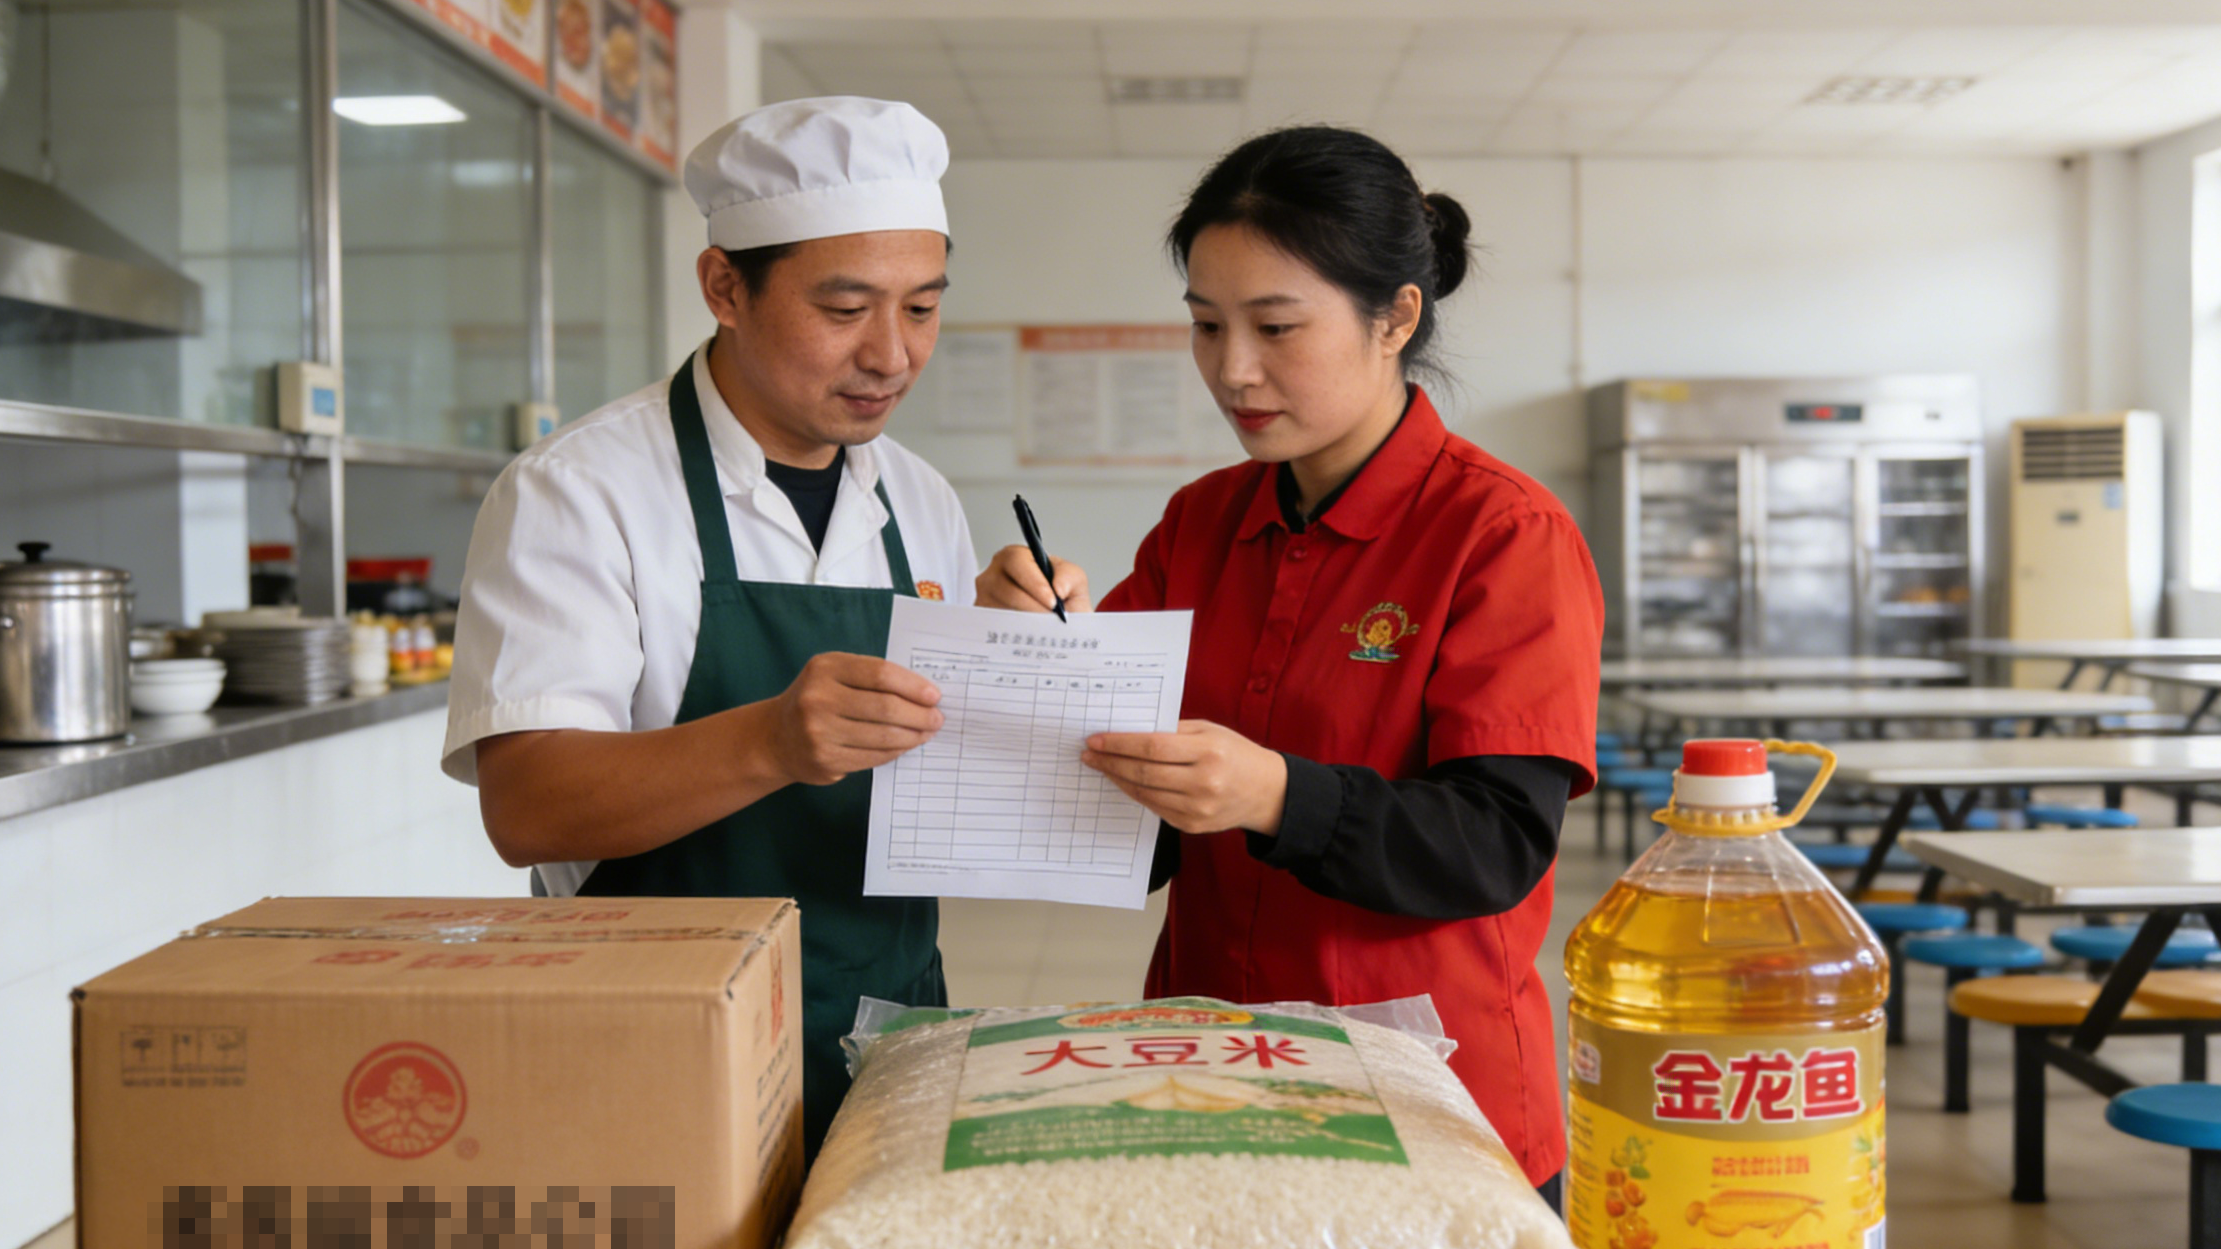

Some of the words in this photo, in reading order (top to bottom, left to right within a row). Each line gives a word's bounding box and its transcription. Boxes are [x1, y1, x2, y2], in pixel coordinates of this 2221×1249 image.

[1022, 1034, 1309, 1075] 大豆米
[1653, 1048, 1862, 1121] 金龙鱼
